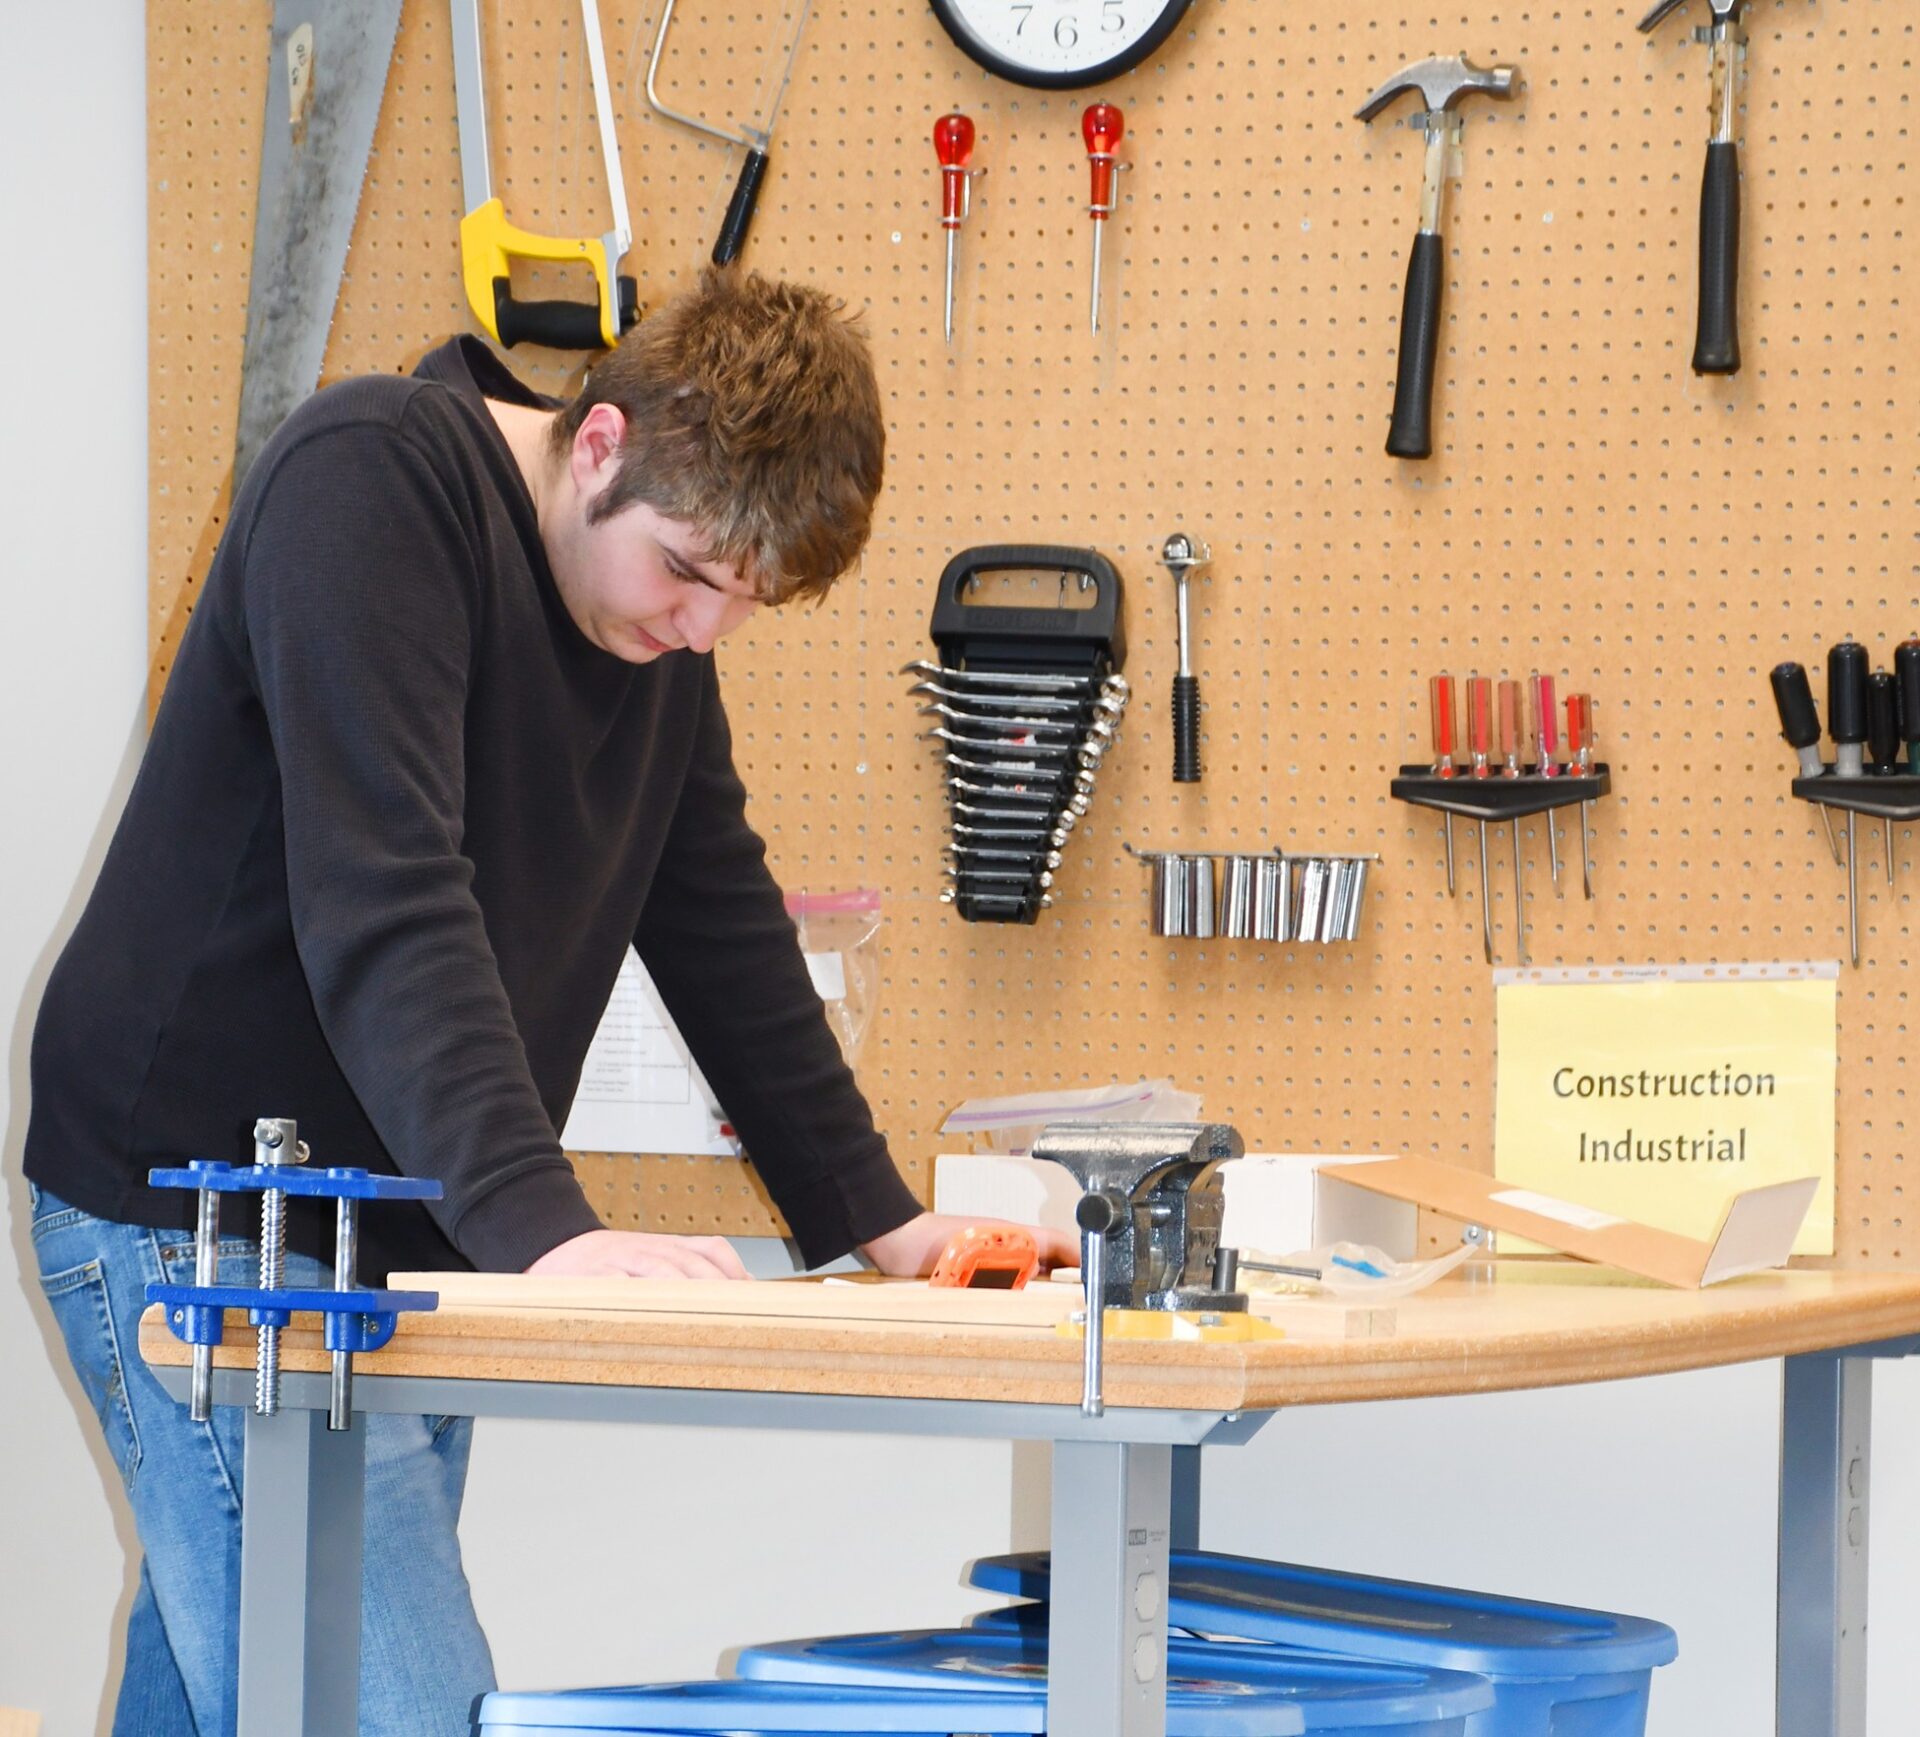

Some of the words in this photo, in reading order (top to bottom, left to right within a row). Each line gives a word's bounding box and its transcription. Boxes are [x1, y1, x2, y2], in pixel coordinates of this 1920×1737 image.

[1010, 5, 1033, 36] 7
[1053, 15, 1079, 49] 6
[1100, 1, 1125, 33] 5
[1553, 1063, 1776, 1098] Construction
[1578, 1127, 1747, 1163] Industrial
